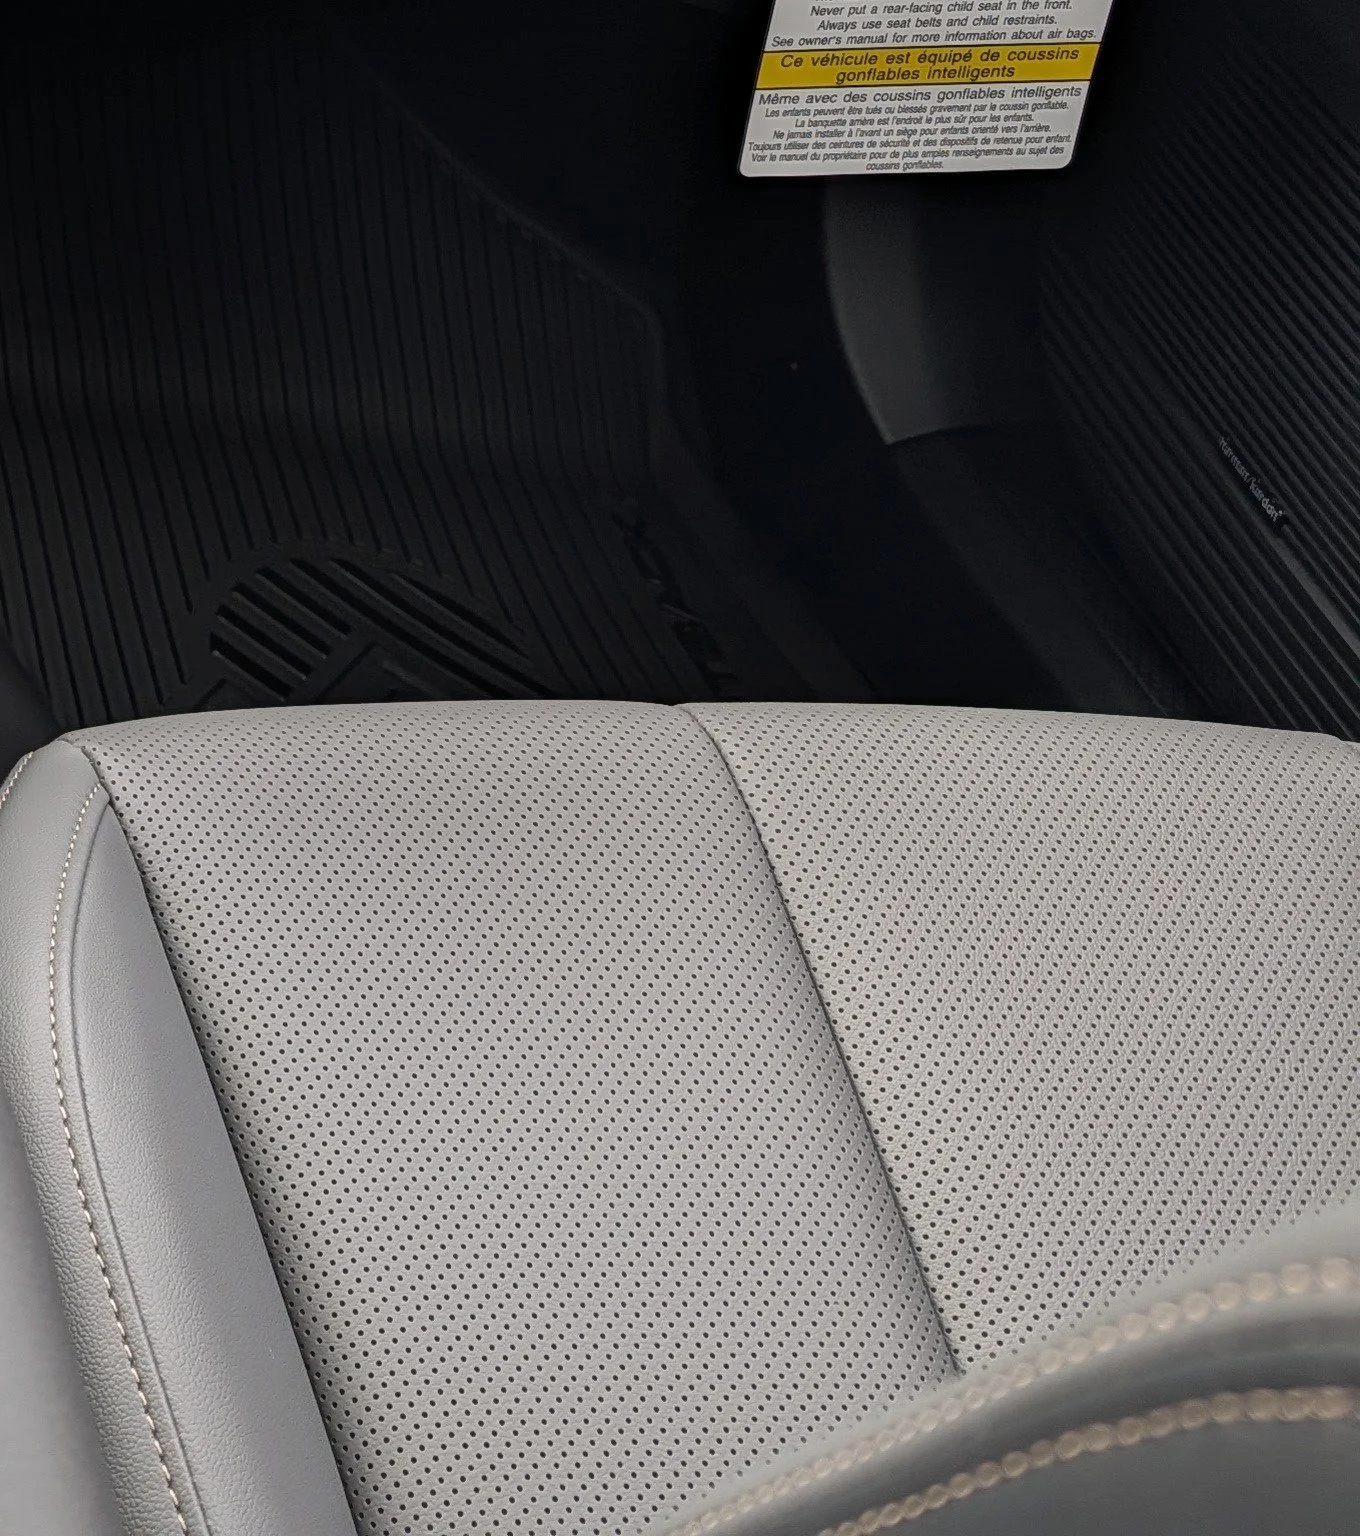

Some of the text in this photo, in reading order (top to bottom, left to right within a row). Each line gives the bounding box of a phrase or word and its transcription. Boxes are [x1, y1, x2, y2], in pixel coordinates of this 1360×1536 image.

[810, 0, 1072, 17] Never put a rear-facing child seat in the front.
[817, 14, 1058, 32] Always use seat belts and child restraints.
[771, 28, 1097, 47] See owner's manual for more information about air bags.
[781, 47, 1079, 68] Ce véhicule est équipé de coussins
[835, 65, 1015, 85] gonflables intelligents
[758, 86, 1082, 106] Même avec des coussins gonflables intelligents
